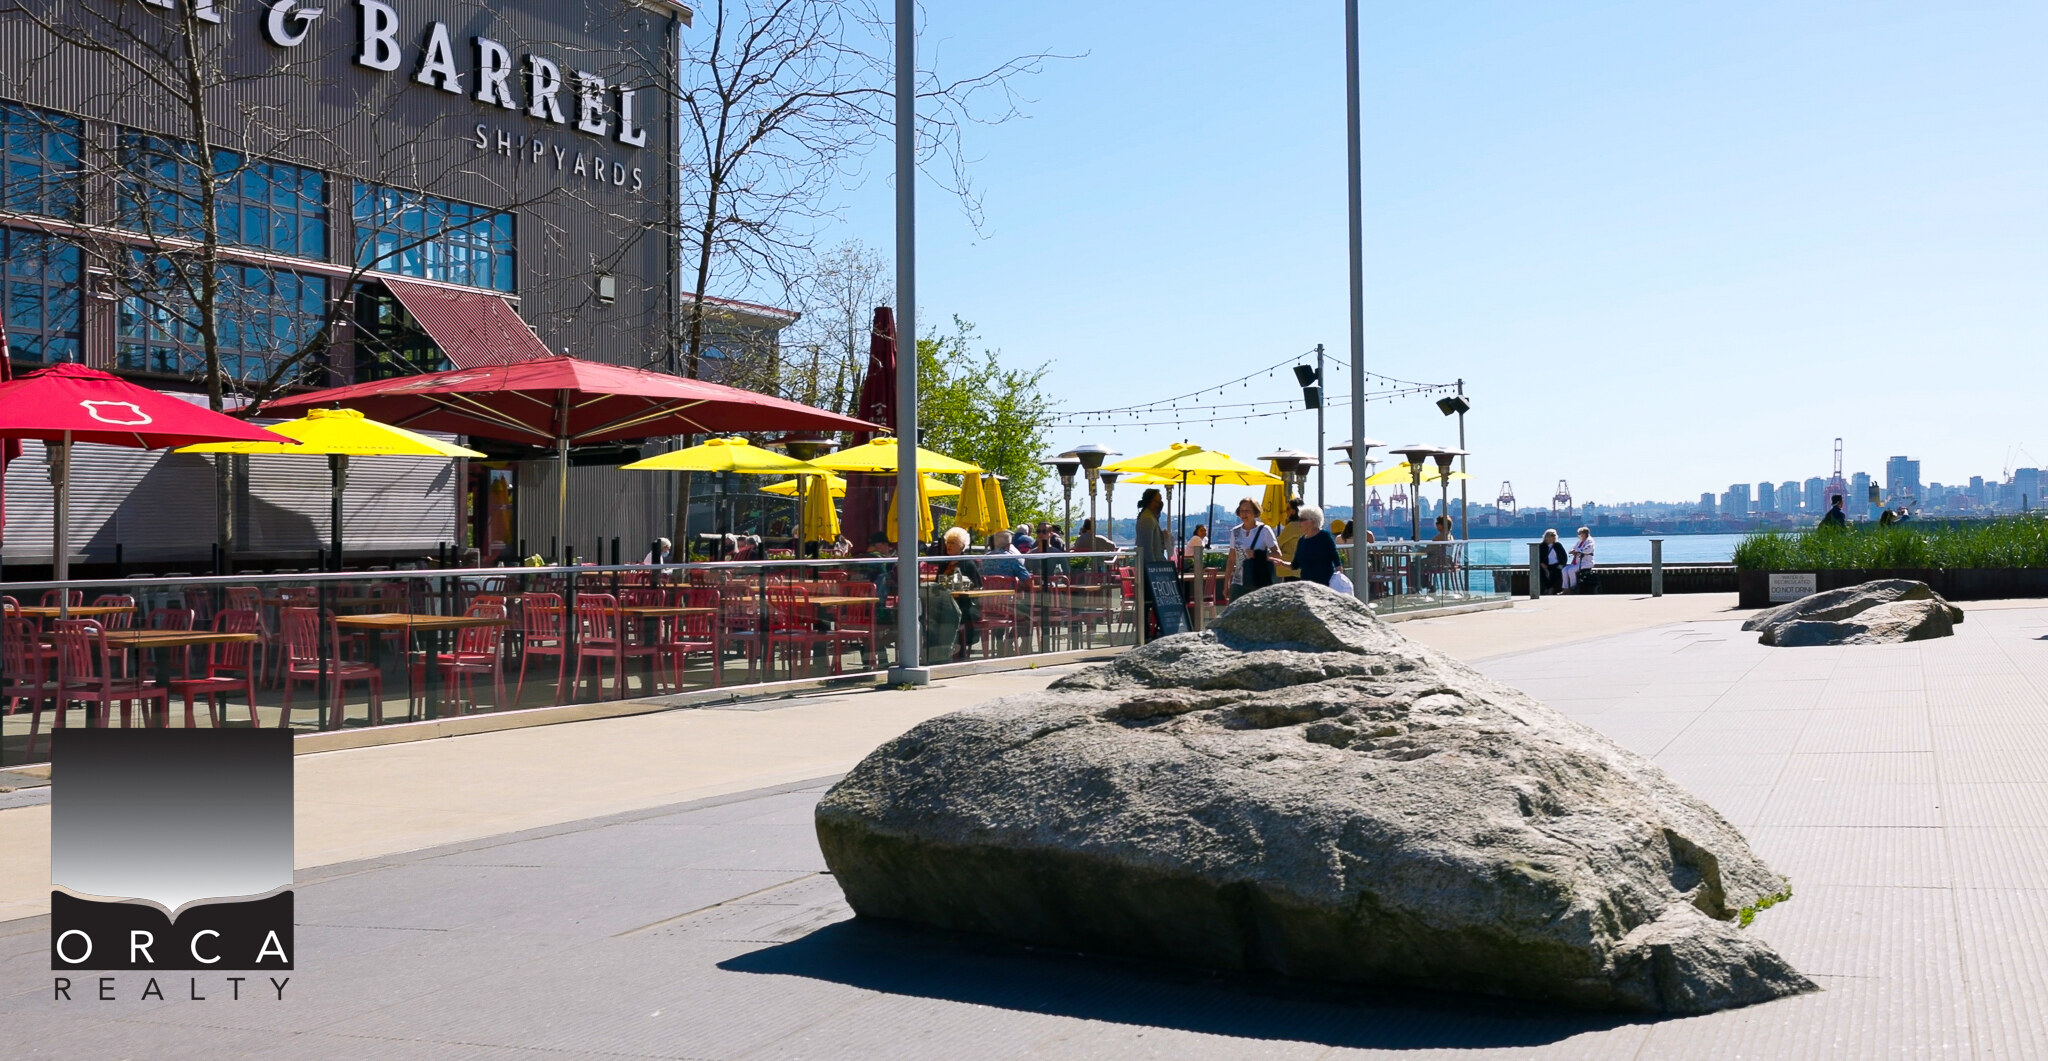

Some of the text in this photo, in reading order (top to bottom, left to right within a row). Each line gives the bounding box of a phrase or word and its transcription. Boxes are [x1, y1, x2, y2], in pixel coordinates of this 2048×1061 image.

[354, 0, 647, 148] BARREL
[475, 123, 643, 191] SHIPYARDS
[1151, 580, 1179, 596] FRONT
[1155, 595, 1183, 607] ENTRANCE
